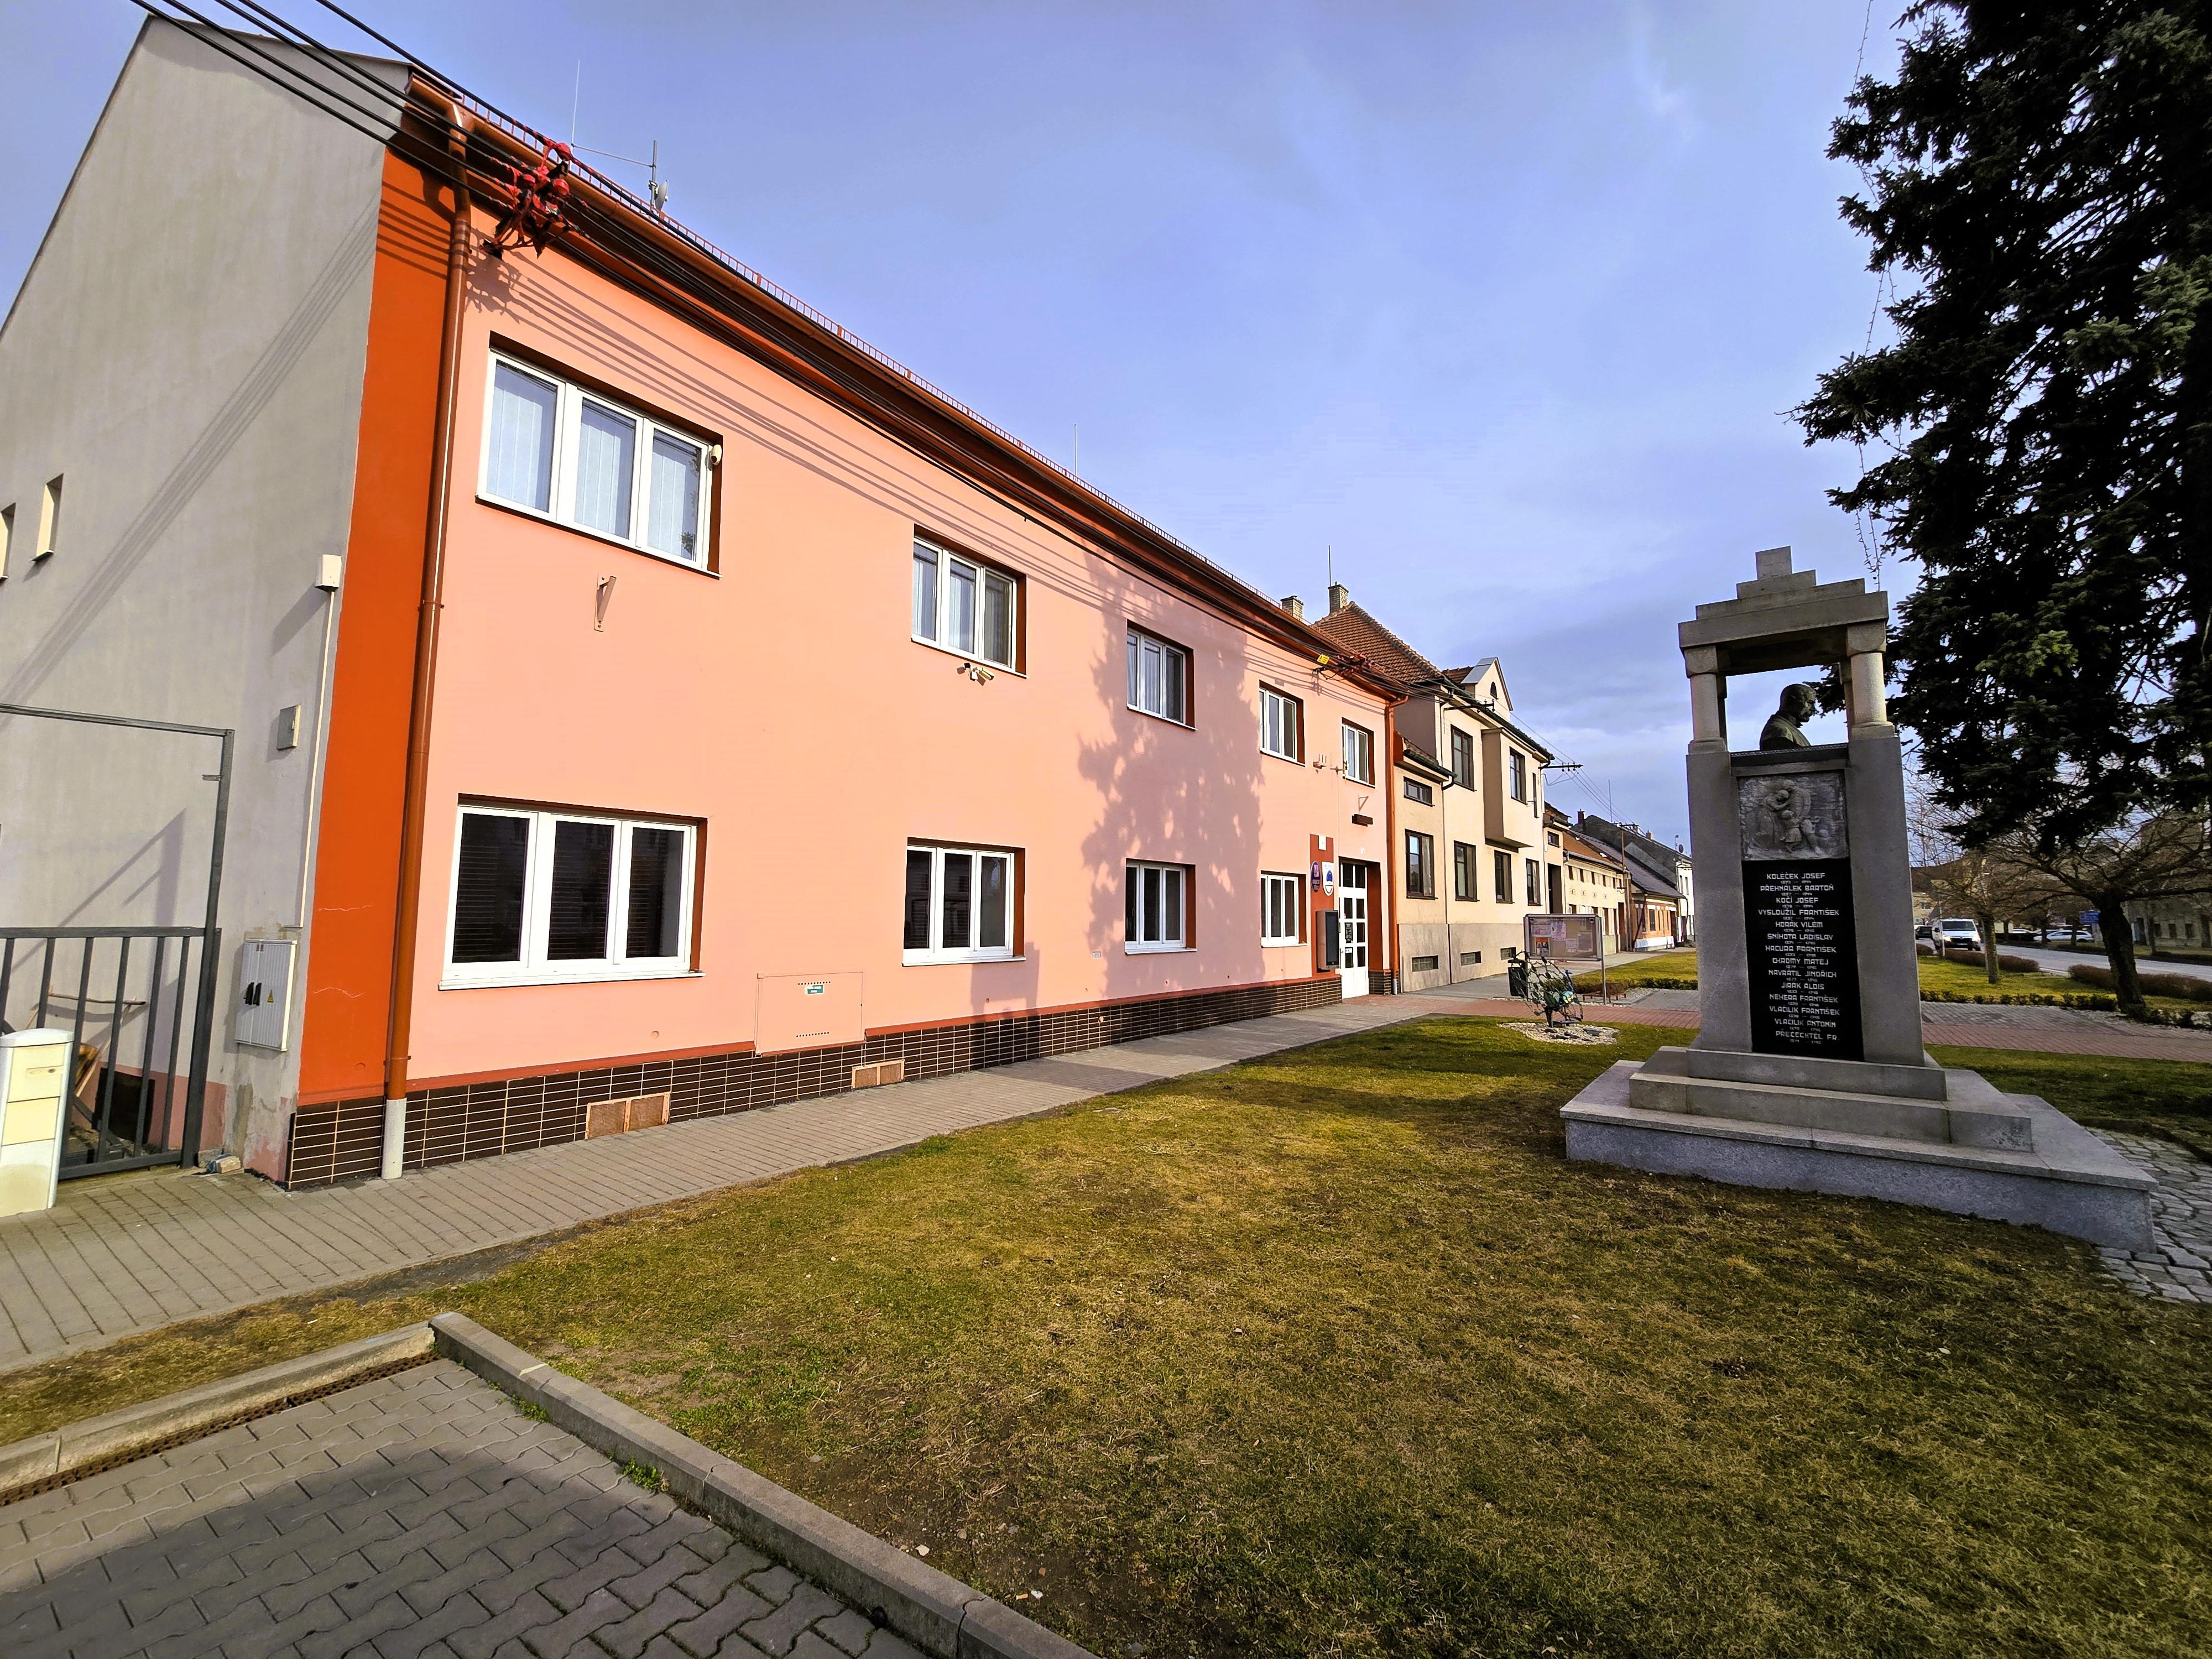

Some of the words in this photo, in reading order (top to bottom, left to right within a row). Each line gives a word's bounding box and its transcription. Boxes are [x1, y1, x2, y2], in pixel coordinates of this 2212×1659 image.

[1775, 920, 1798, 928] HORÁK
[1768, 968, 1802, 977] NAVRÁTIL
[1799, 994, 1838, 1003] FRANTIŠEK
[1801, 1007, 1840, 1015] FRANTIŠEK
